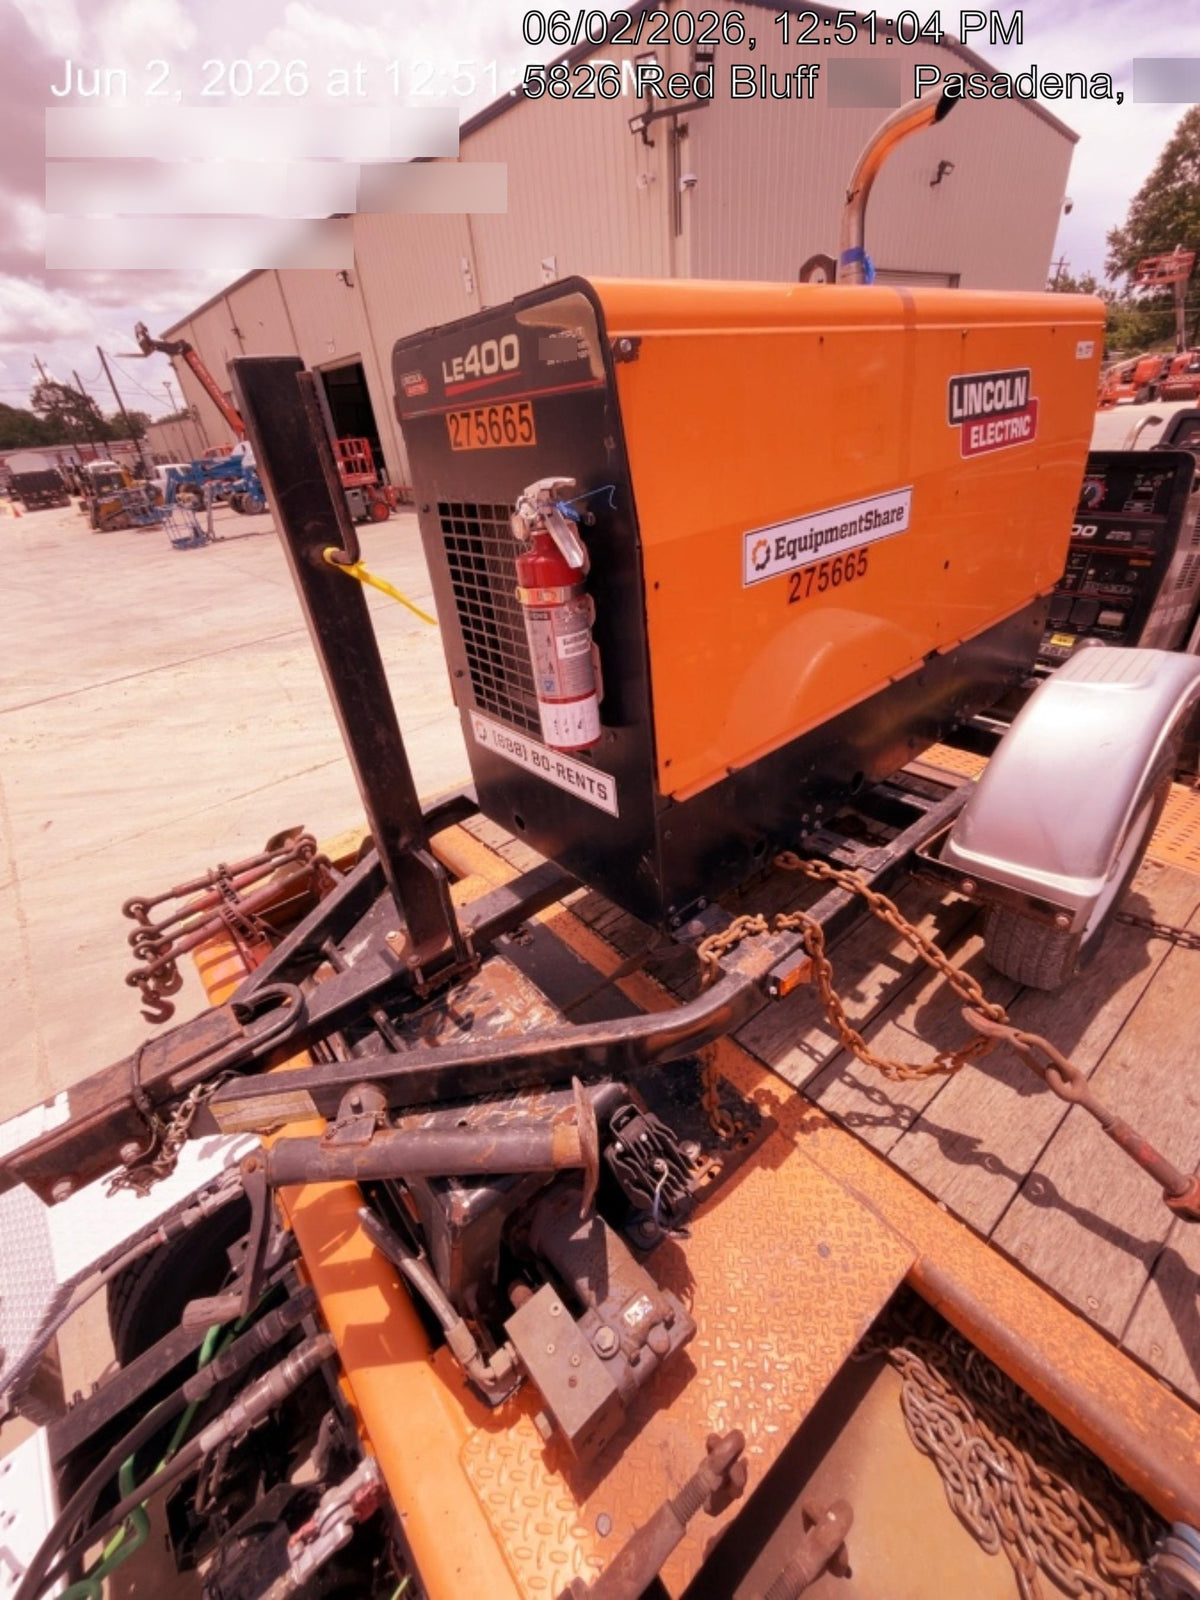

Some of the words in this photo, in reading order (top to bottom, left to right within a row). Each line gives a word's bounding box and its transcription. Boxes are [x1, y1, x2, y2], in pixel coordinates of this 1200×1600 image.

[442, 333, 520, 384] LE400
[953, 376, 1027, 418] LINCOLN
[449, 403, 532, 447] 275665
[970, 415, 1031, 449] ELECTRIC
[774, 505, 905, 561] EquipmentShare
[788, 549, 868, 604] 275665
[492, 730, 528, 763] (888)
[531, 750, 608, 801] 80-RENTS
